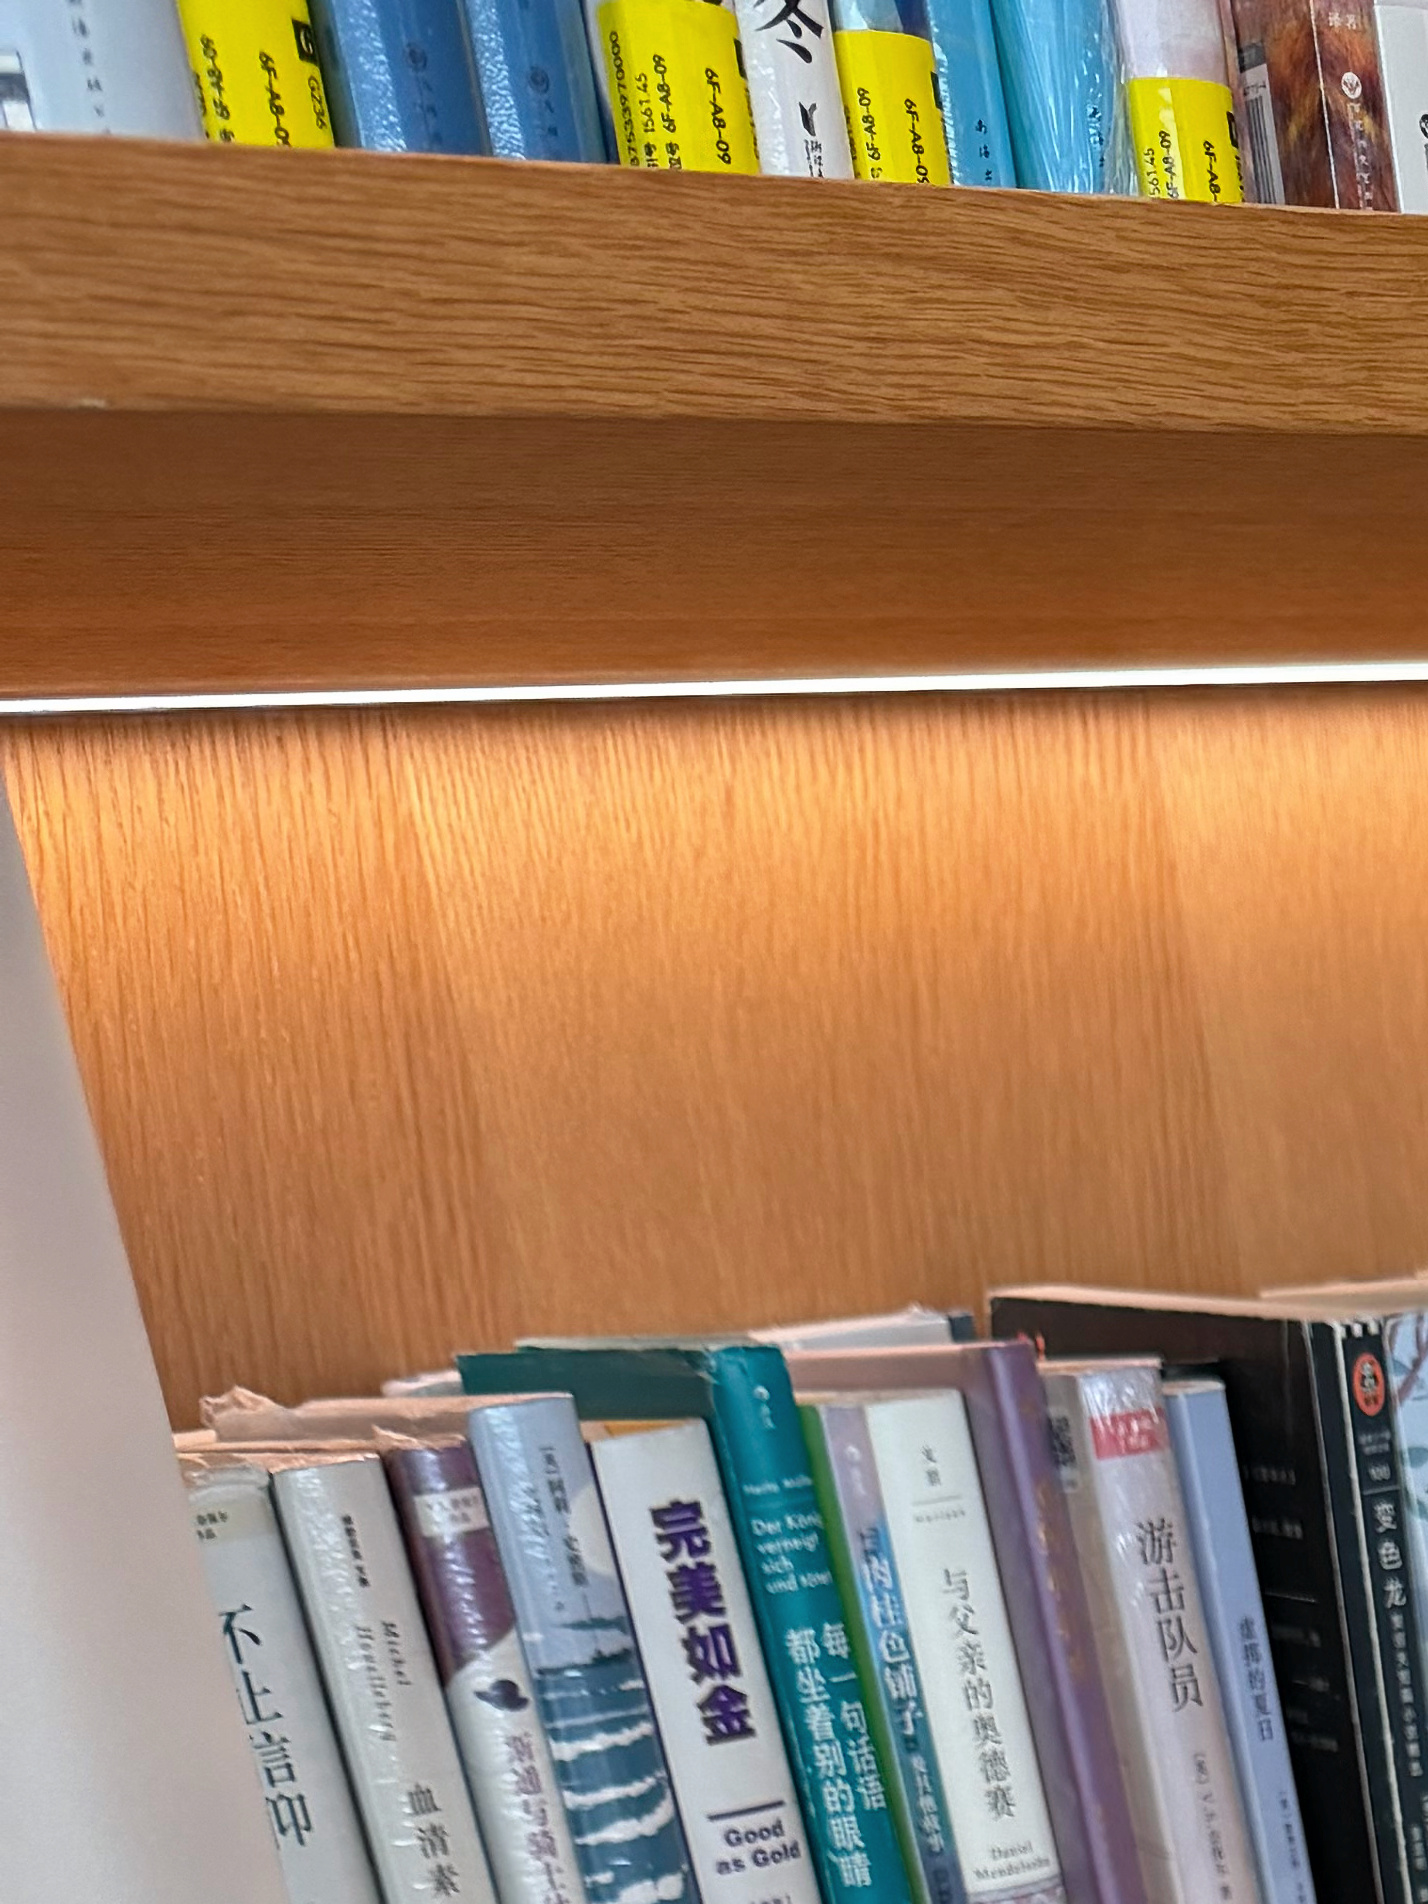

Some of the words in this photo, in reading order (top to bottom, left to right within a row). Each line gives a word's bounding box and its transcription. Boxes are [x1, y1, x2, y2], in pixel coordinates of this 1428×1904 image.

[653, 54, 677, 134] 6F-A8-09
[704, 67, 732, 165] 6F-A8-09
[857, 87, 881, 163] 6F-A8-09
[1159, 130, 1180, 199] 6F-A8-09
[1372, 1499, 1408, 1610] 变色龙
[648, 1499, 757, 1747] 完美如金
[1136, 1517, 1204, 1713] 游击队员
[821, 1622, 889, 1812] 每一句话语
[942, 1567, 1017, 1820] 与父亲的奥德赛
[786, 1626, 873, 1889] 都坐着别的眼睛
[714, 1852, 746, 1877] as
[750, 1843, 801, 1870] Gold
[723, 1818, 787, 1849] Good
